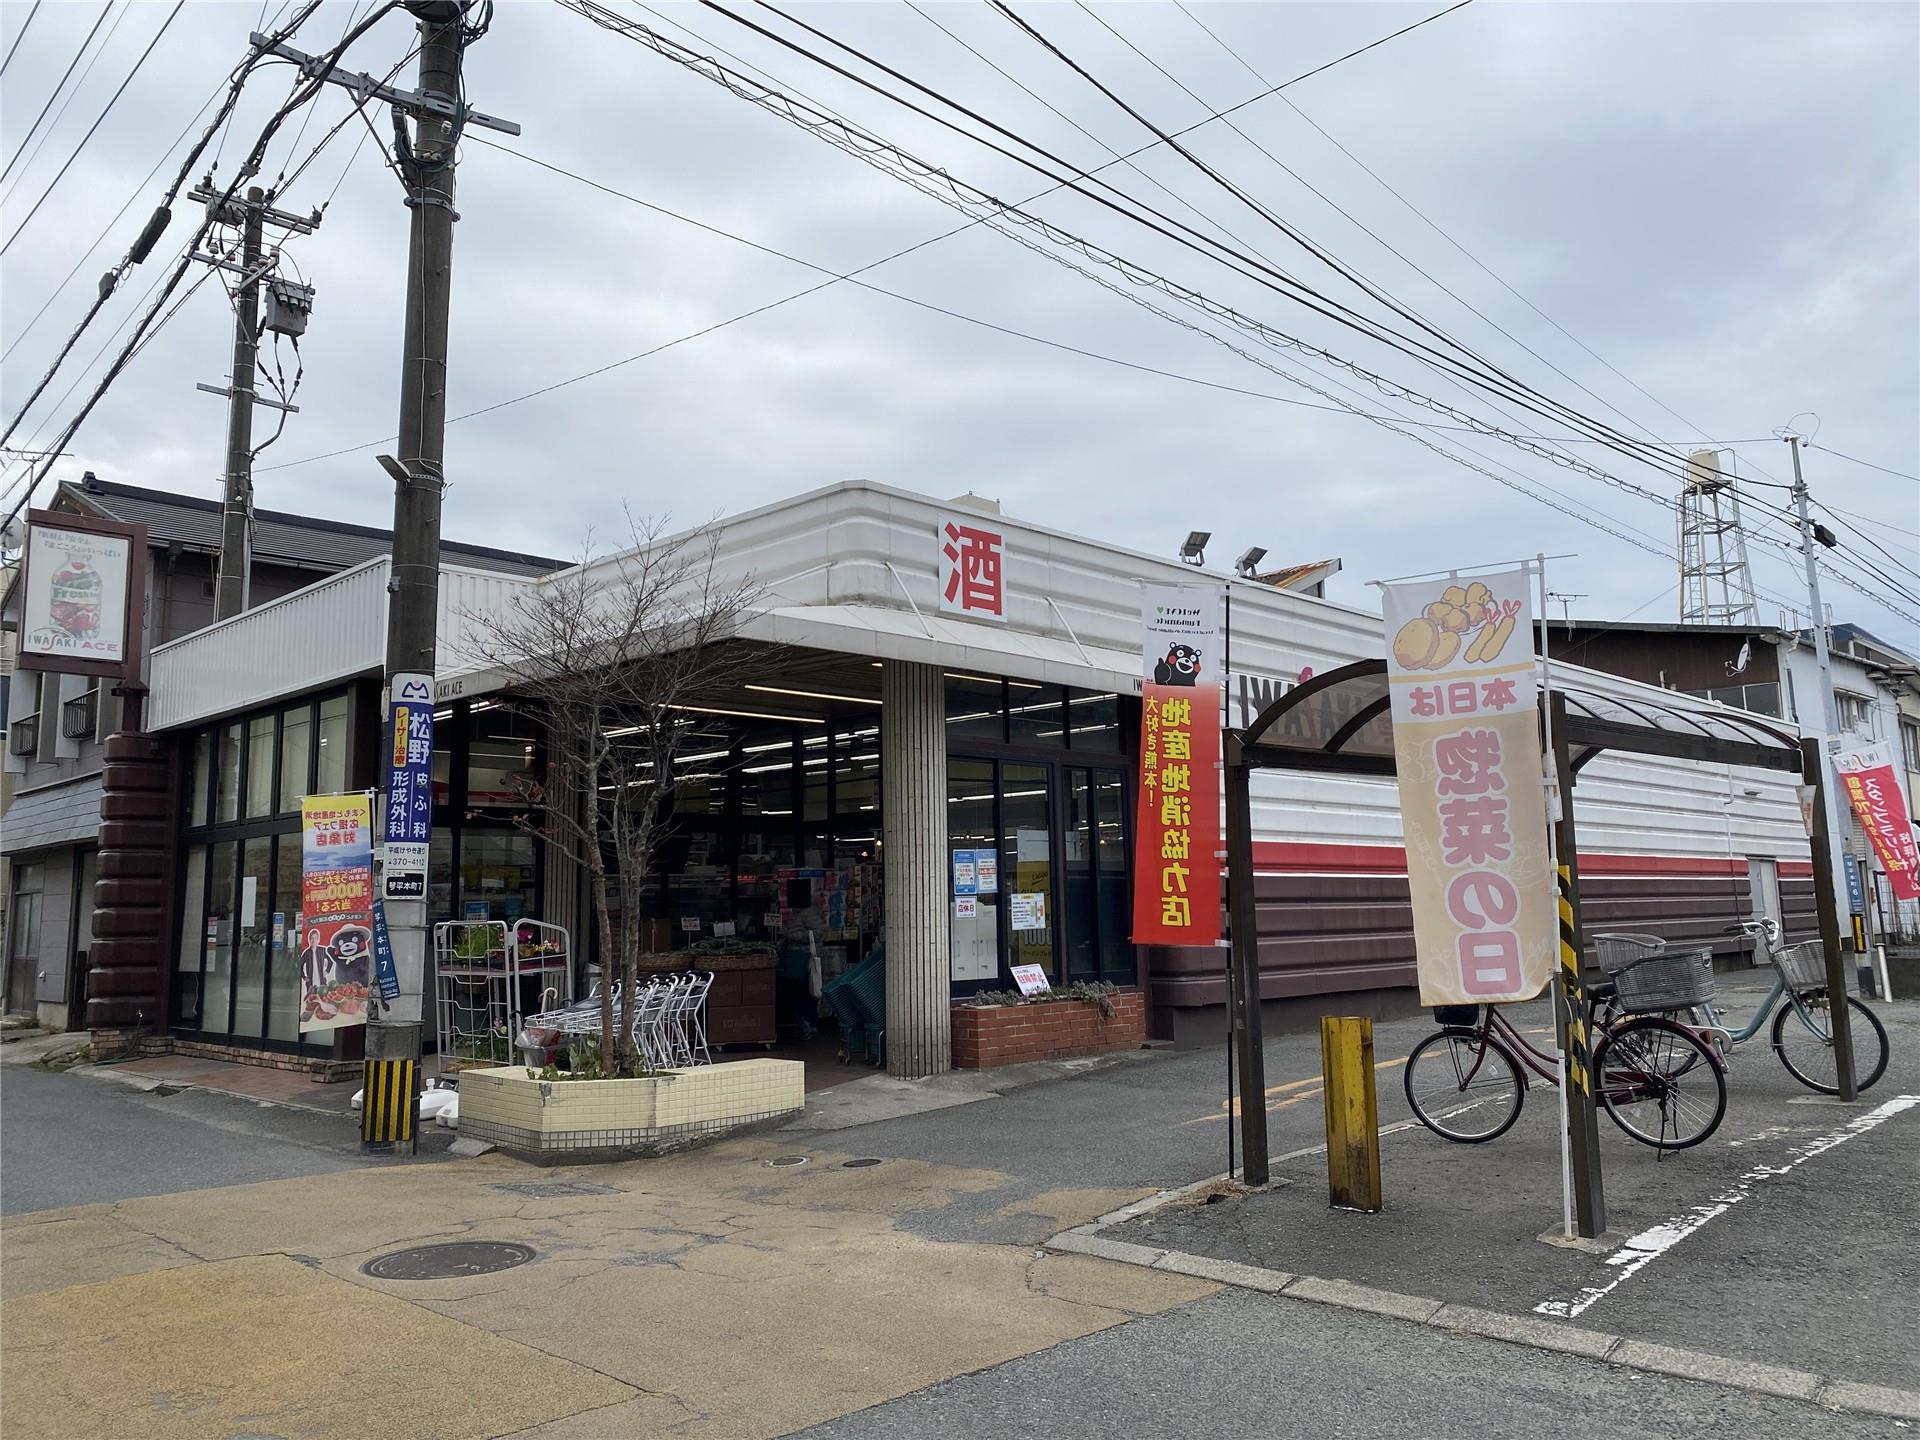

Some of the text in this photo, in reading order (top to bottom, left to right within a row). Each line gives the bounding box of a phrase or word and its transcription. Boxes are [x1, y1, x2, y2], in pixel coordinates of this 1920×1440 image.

[943, 521, 1002, 616] 酒
[28, 633, 119, 652] IWASAKI ACE
[451, 680, 463, 695] ACE
[408, 712, 431, 765] 松野
[389, 770, 409, 837] 形成外科
[392, 857, 425, 866] 370-4112
[388, 881, 423, 891] 琴平本町7
[958, 904, 975, 913] 店休日
